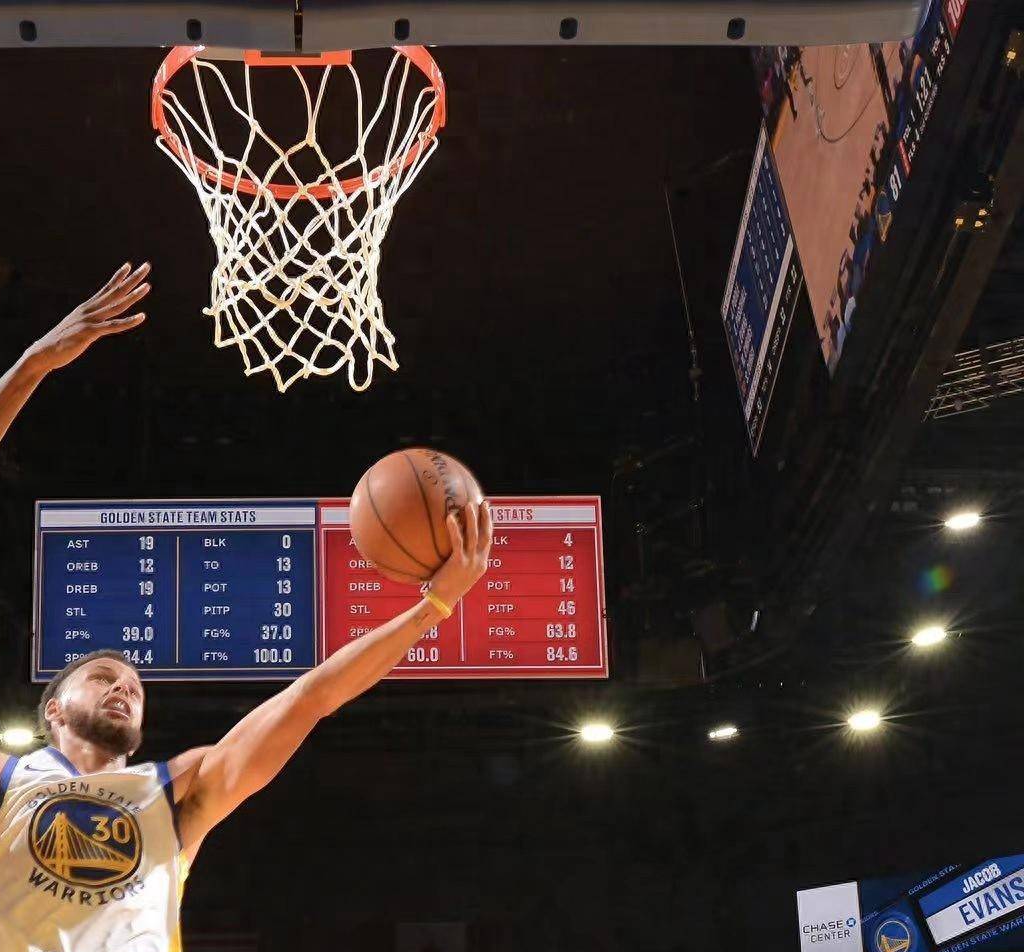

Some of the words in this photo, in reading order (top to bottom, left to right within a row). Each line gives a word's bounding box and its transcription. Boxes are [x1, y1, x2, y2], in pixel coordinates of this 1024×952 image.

[100, 512, 145, 524] GOLDEN
[148, 511, 183, 523] STATE
[186, 511, 218, 523] TEAM
[220, 510, 256, 523] STATS
[497, 508, 533, 521] STATS
[67, 539, 89, 549] AST
[138, 536, 154, 550] 19
[204, 538, 226, 547] BLK
[282, 535, 291, 549] 0
[563, 533, 573, 547] 4
[67, 562, 98, 571] OREB
[139, 559, 154, 573] 12
[204, 561, 219, 570] TO
[276, 557, 291, 572] 13
[488, 559, 502, 568] TO
[559, 555, 574, 570] 12
[66, 585, 98, 594] DREB
[138, 581, 154, 595] 19
[204, 583, 228, 592] POT
[276, 580, 291, 594] 13
[349, 582, 381, 591] DREB
[487, 581, 510, 590] POT
[559, 578, 574, 593] 14
[66, 608, 86, 617] STL
[144, 604, 154, 618] 4
[204, 606, 230, 615] PITP
[273, 602, 292, 617] 30
[350, 605, 371, 614] STL
[488, 604, 514, 613] PITP
[557, 601, 575, 615] 46
[65, 630, 90, 640] 2P%
[122, 627, 154, 641] 39.0
[204, 628, 230, 638] FG%
[261, 625, 292, 640] 37.0
[489, 627, 515, 636] FG%
[546, 624, 576, 638] 63.8
[204, 652, 228, 661] FT%
[254, 649, 292, 663] 100.0
[407, 647, 439, 662] 60.0
[489, 650, 514, 659] FT%
[546, 647, 577, 661] 84.6
[27, 782, 90, 809] GOLDEN
[90, 815, 132, 844] 30
[962, 863, 1001, 894] JACOB
[29, 867, 145, 906] WARRIORS
[958, 875, 1024, 926] EVANS
[803, 920, 843, 934] CHASE
[811, 930, 851, 943] CENTER
